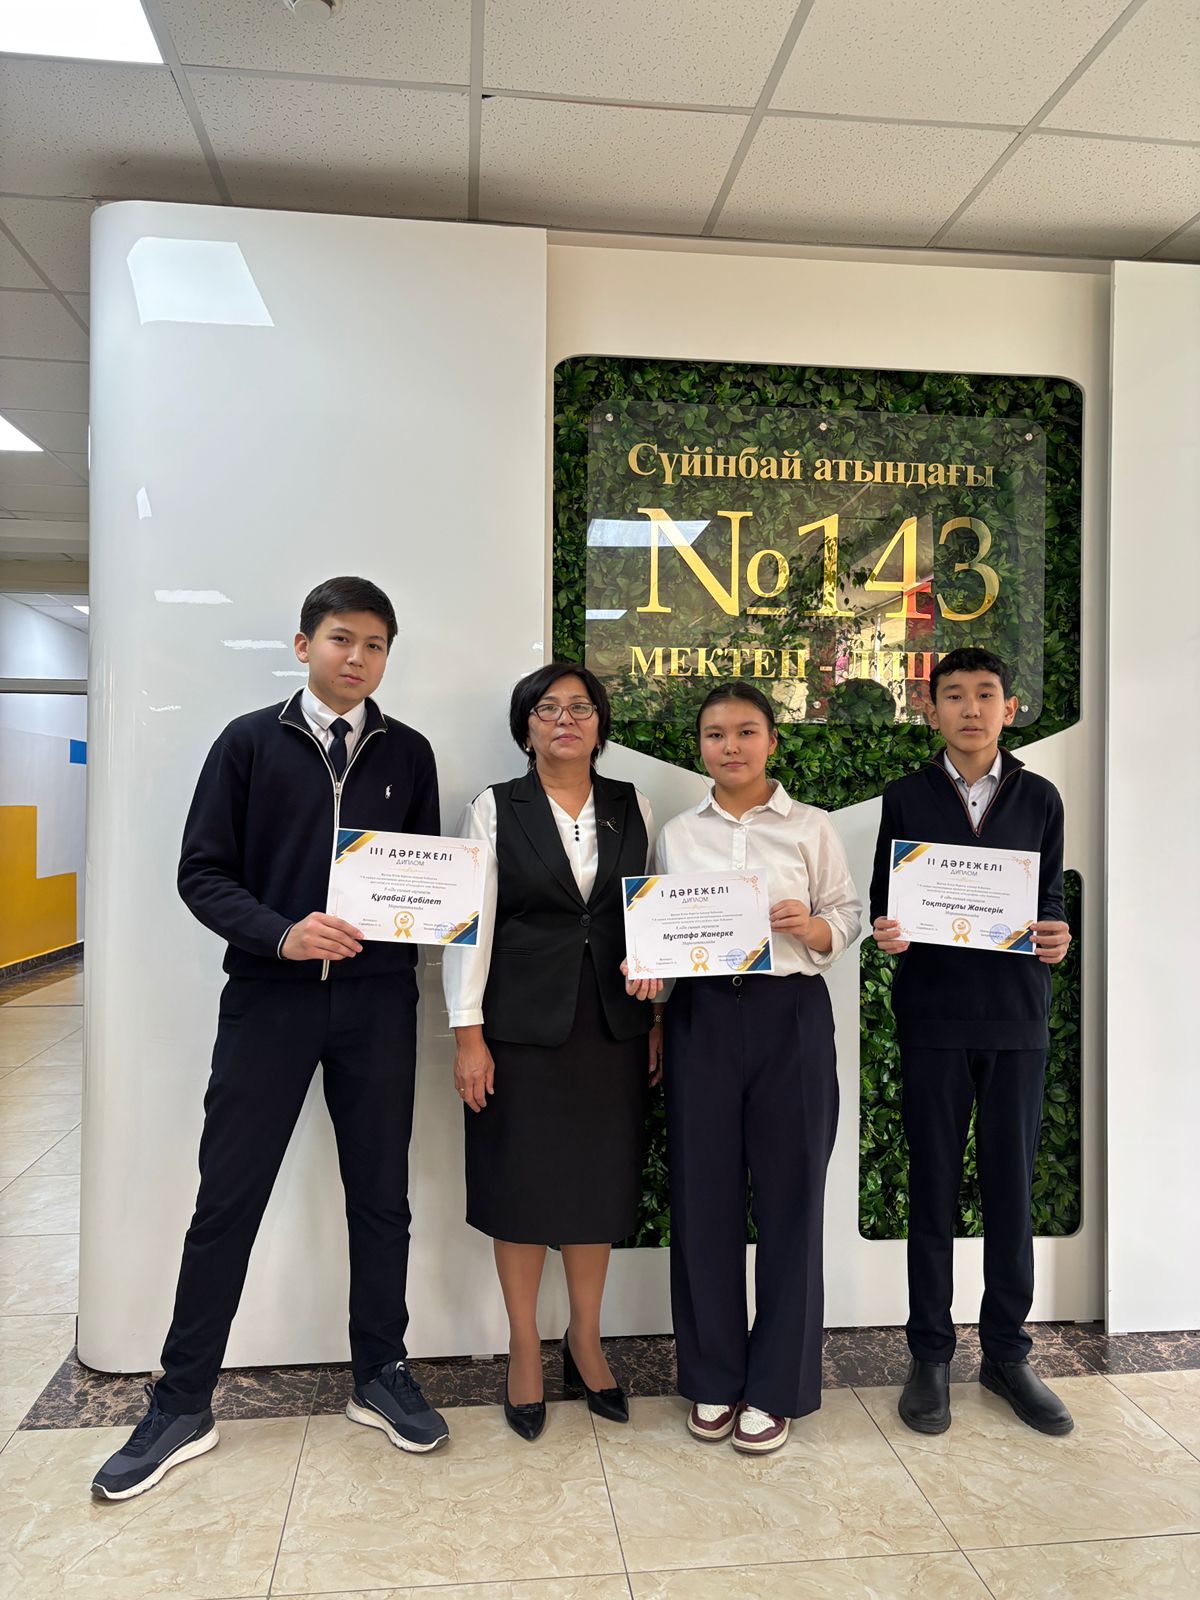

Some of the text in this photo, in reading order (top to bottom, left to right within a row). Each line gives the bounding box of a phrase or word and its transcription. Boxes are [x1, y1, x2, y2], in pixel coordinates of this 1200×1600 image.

[628, 442, 994, 488] Сүйінбай атындағы
[629, 645, 808, 680] МЕКТЕП
[846, 650, 951, 682] ЛИЦ
[388, 848, 453, 862] ДӘРЕЖЕЛІ
[396, 859, 425, 867] ДИПЛОМ
[940, 859, 1003, 872] ДӘРЕЖЕЛІ
[950, 869, 978, 877] ДИПЛОМ
[371, 892, 442, 905] Құлабай Қабілет
[669, 886, 729, 899] ДӘРЕЖЕЛІ
[681, 896, 709, 904] ДИПЛОМ
[921, 899, 1004, 915] Тоқтарұлы Жансерік
[662, 930, 734, 942] Мұстафа Жанерке
